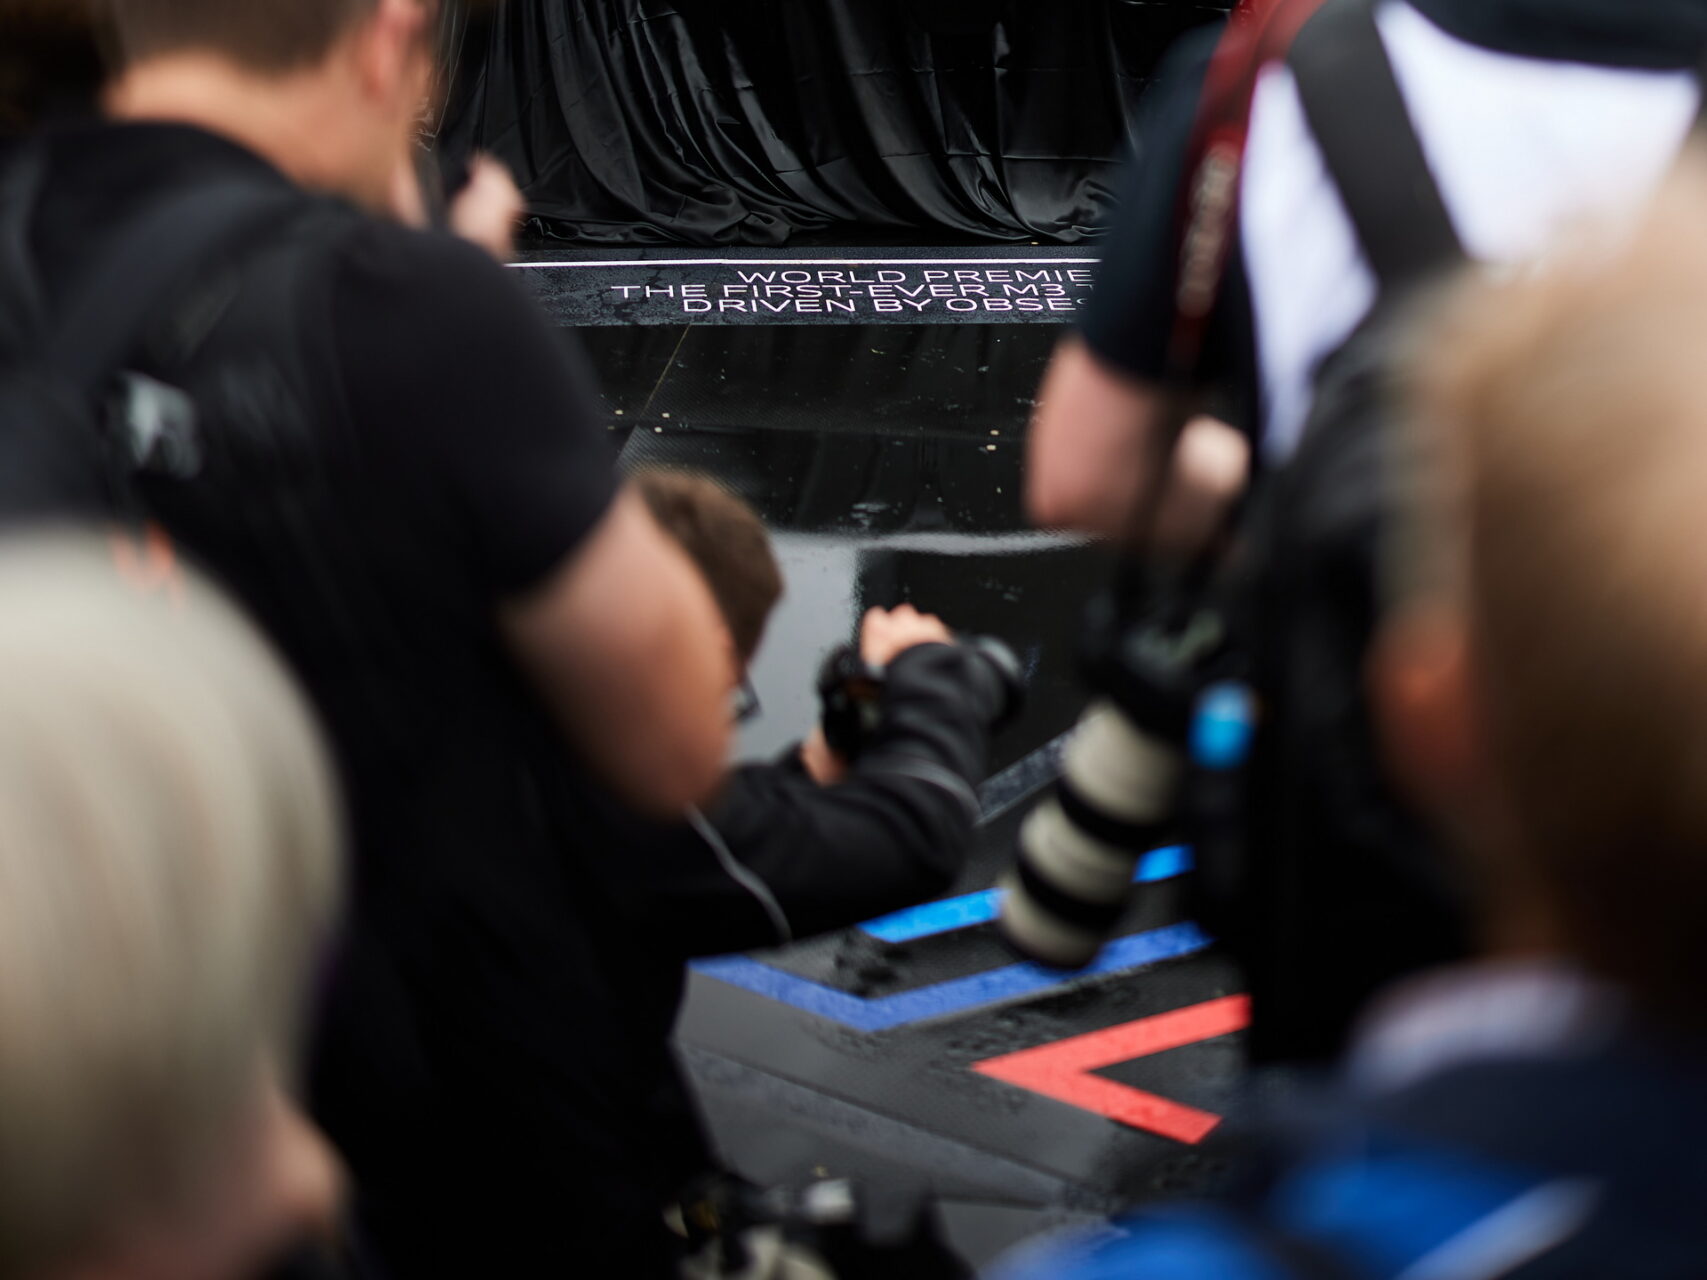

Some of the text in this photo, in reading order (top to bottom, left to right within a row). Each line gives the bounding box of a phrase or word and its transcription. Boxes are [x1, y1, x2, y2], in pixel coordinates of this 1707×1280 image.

[737, 269, 1094, 283] WORLD PREMIE
[611, 285, 708, 299] THE
[723, 284, 990, 298] FIRST-EVER
[1003, 283, 1066, 297] M3
[683, 299, 856, 313] DRIVEN
[873, 298, 932, 312] BY
